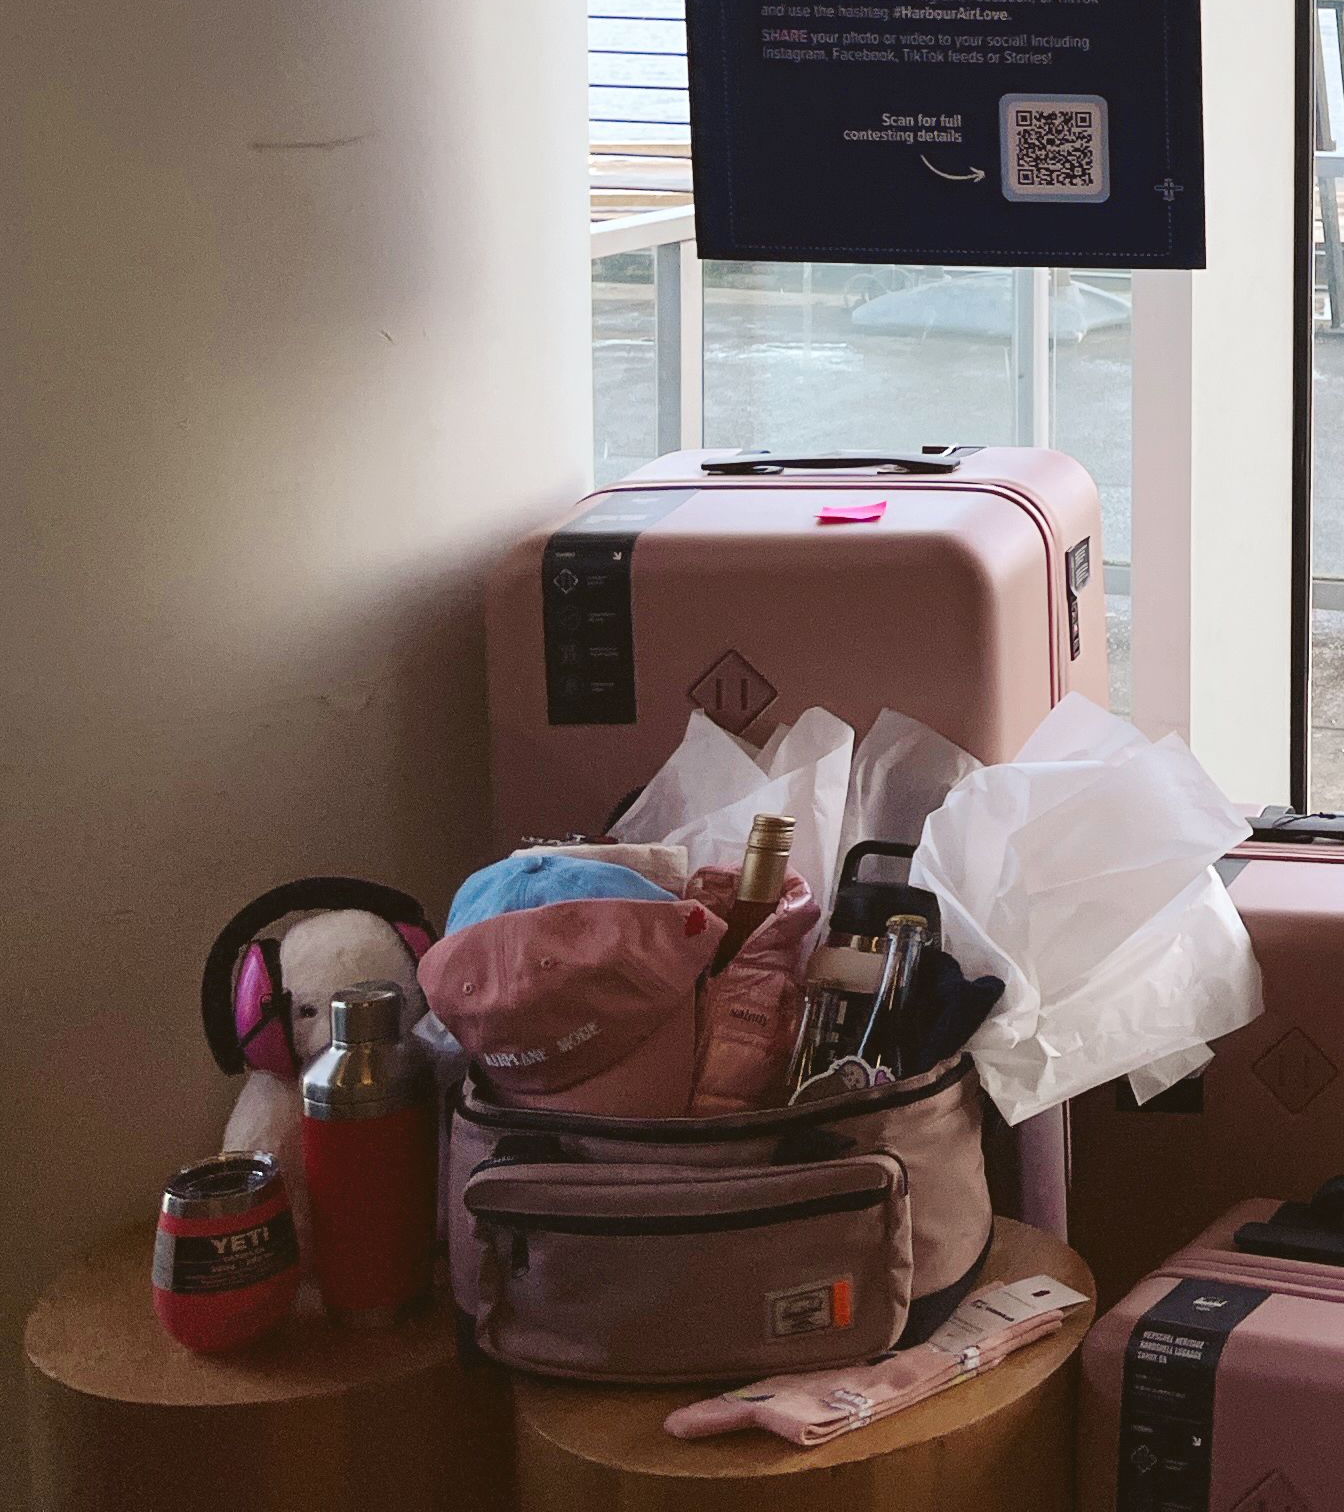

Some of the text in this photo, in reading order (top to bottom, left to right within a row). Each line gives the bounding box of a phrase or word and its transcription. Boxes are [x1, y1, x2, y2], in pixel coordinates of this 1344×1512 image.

[761, 4, 1012, 22] and use the hashtag #HarbourAirLove.
[761, 29, 809, 42] SHARE
[810, 32, 839, 46] your
[842, 31, 879, 46] photo
[883, 34, 897, 45] or
[897, 32, 934, 45] video
[938, 34, 951, 46] to
[954, 36, 983, 49] your
[763, 46, 1053, 65] Instagram, Facebook, TikTok feeds or Stories!
[882, 113, 962, 127] Scan for full
[844, 128, 963, 144] contesting details
[210, 1226, 270, 1254] YETI
